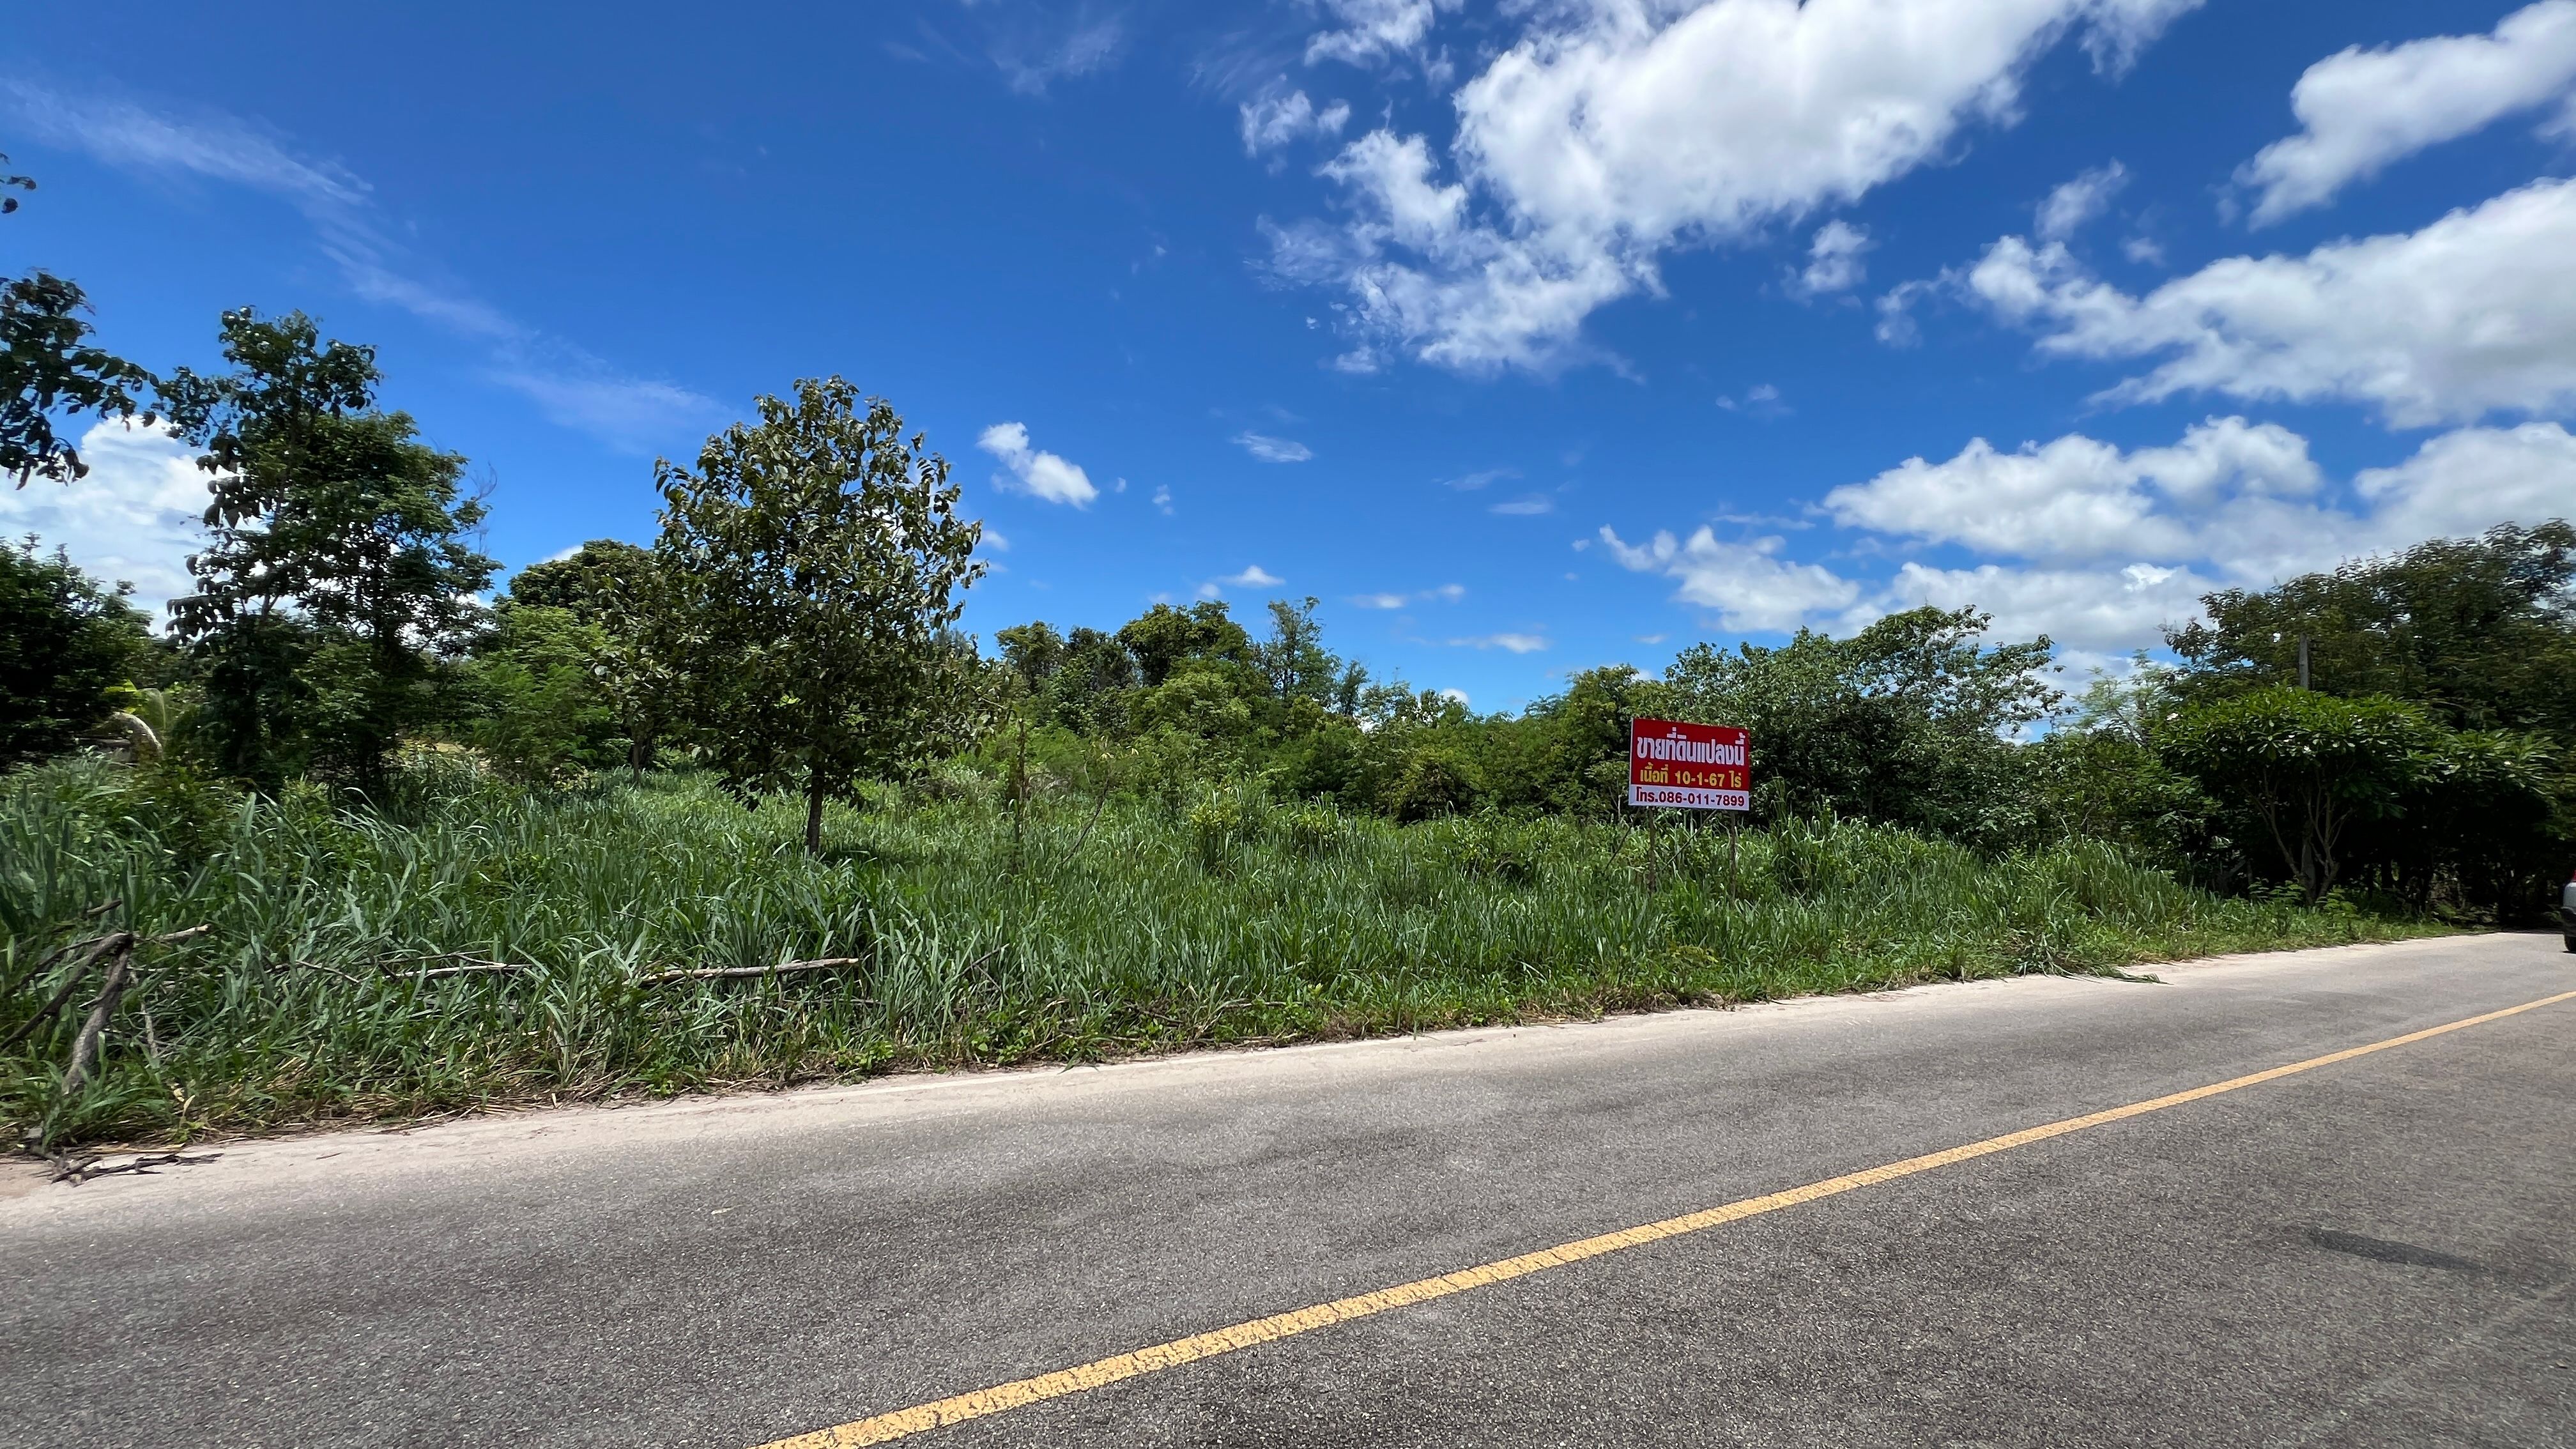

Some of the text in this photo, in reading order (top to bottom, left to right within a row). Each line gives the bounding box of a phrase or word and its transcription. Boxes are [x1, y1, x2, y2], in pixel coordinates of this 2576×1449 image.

[1637, 726, 1745, 766] ขายที่ดินแปลงนี้
[1640, 762, 1742, 788] เนื้อที่ 10-1-67 ไร่
